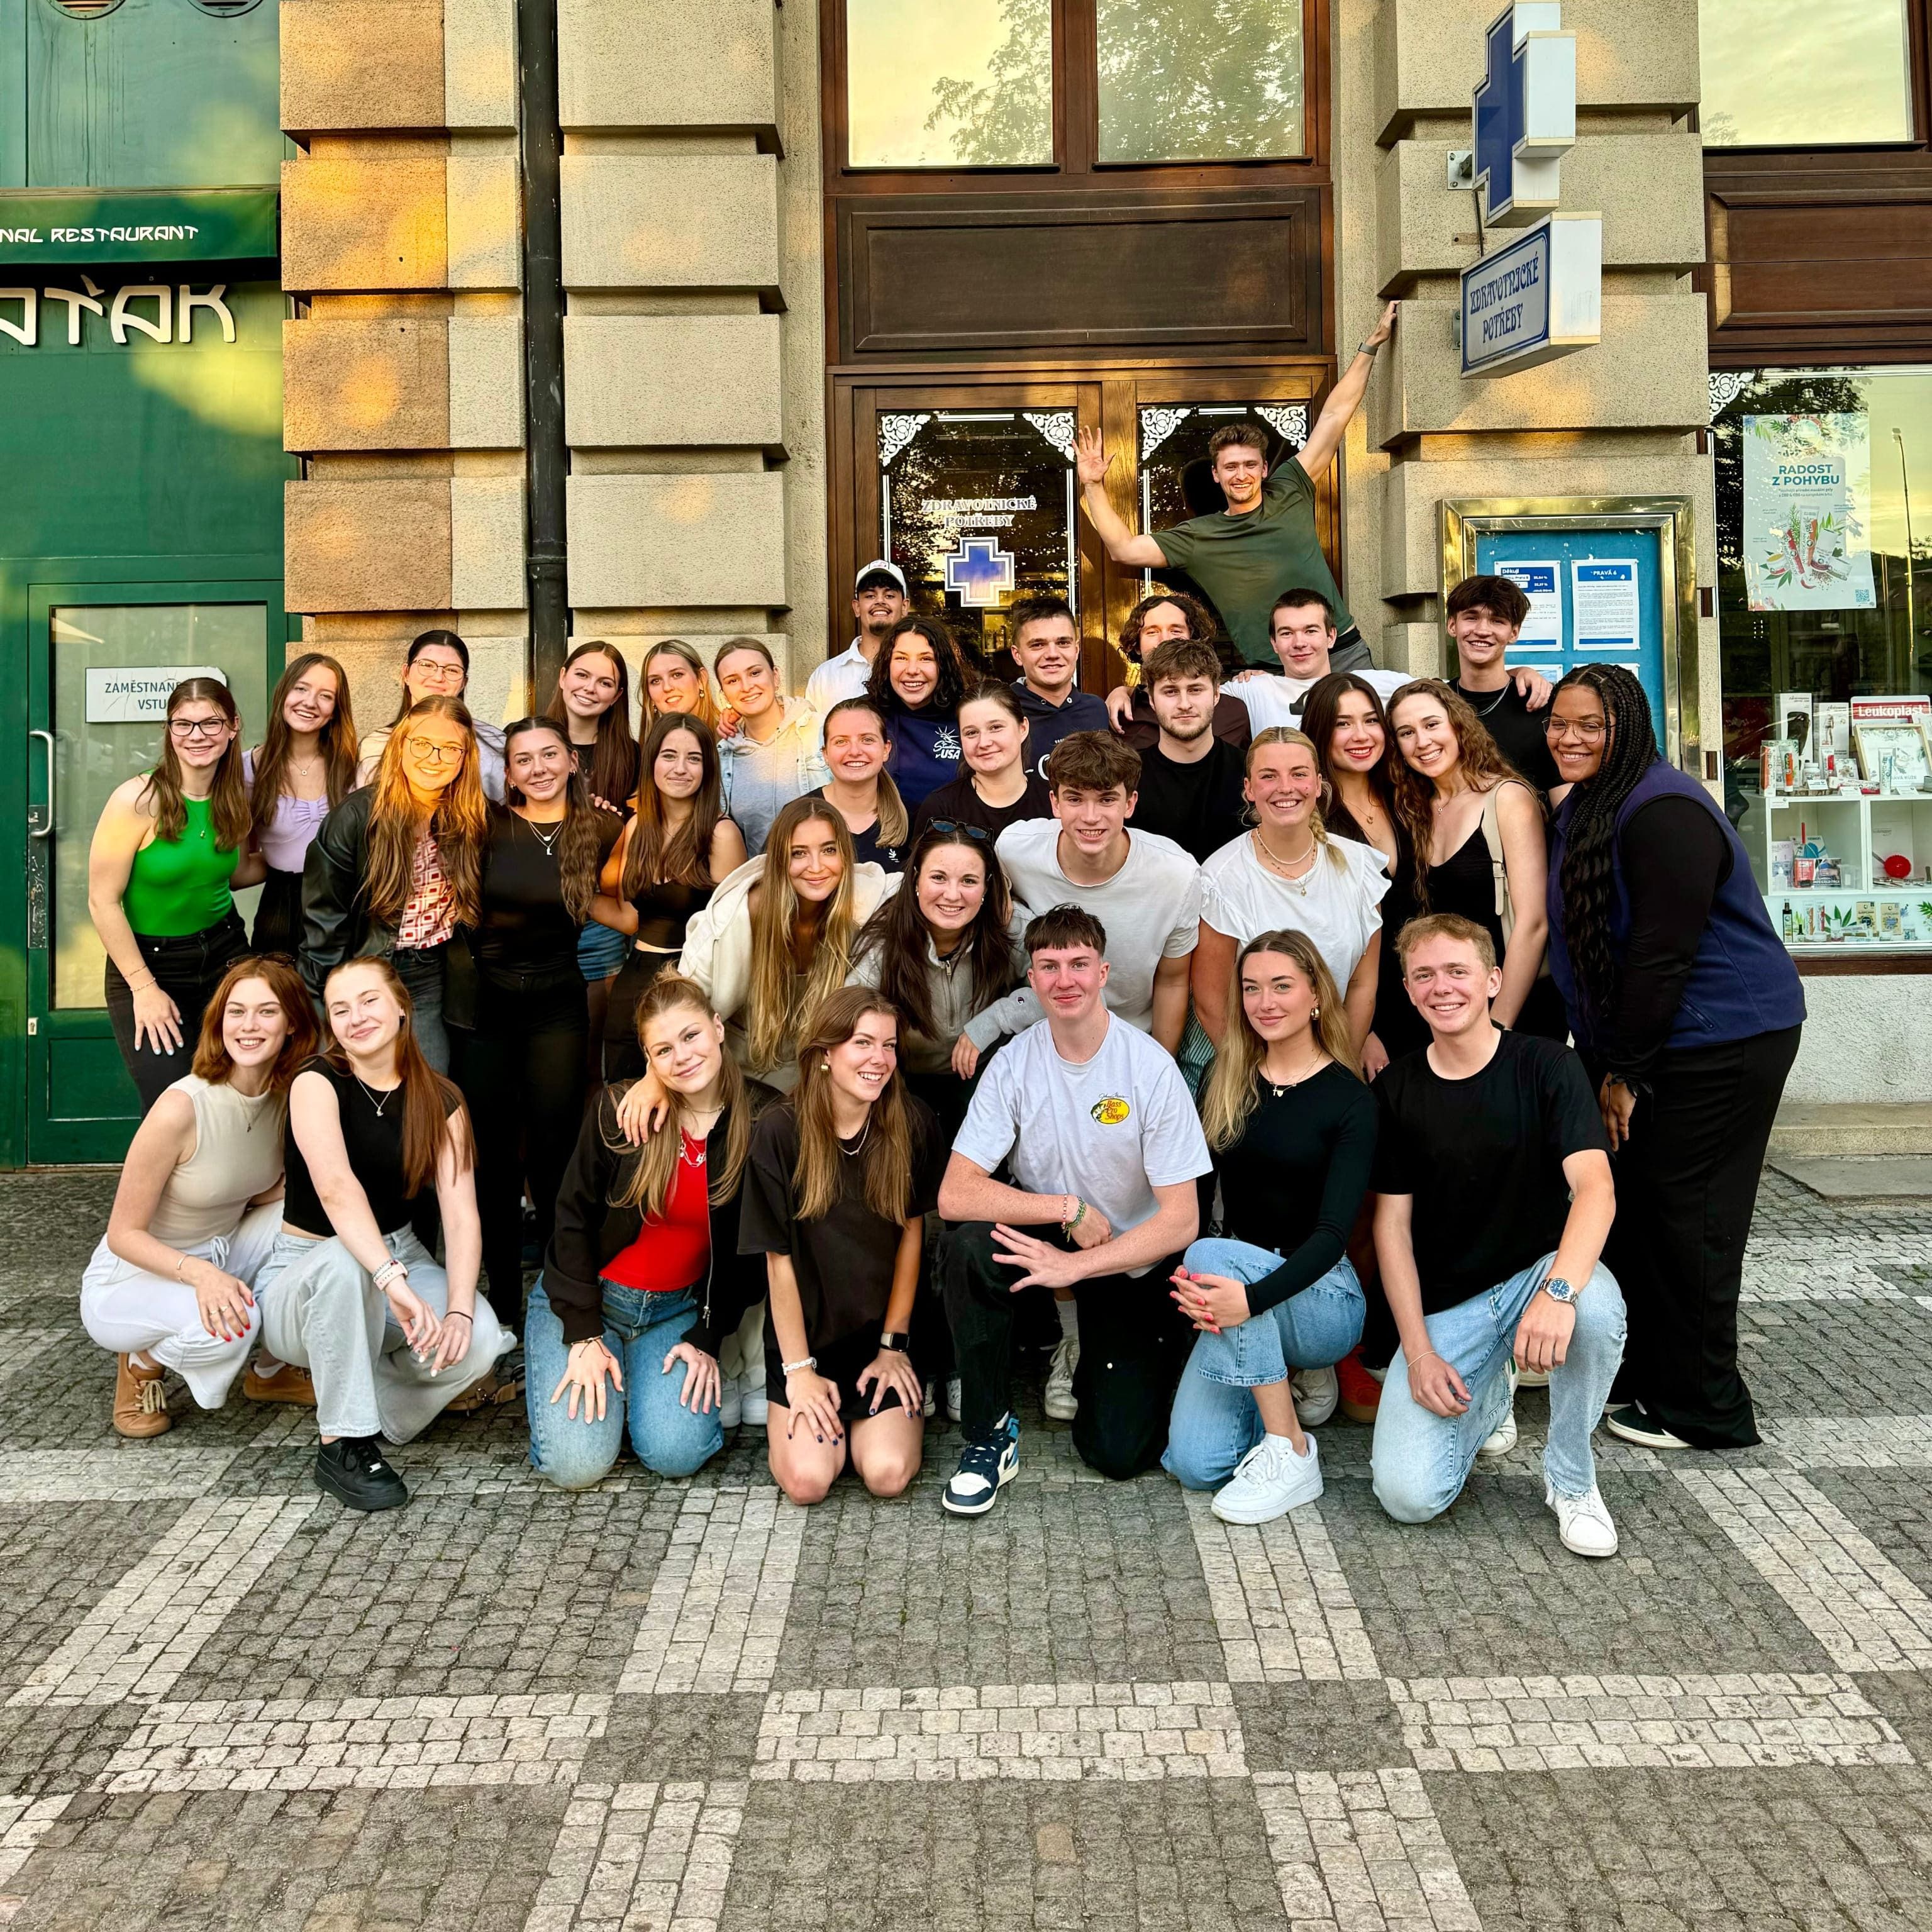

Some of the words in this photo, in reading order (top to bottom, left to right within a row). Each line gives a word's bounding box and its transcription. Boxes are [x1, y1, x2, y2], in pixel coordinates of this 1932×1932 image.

[0, 228, 43, 243] NAL
[51, 226, 199, 243] RESTAURANT
[1470, 252, 1539, 314] ZDRAVOTNICKÉ
[0, 274, 236, 345] AŤAK
[1483, 303, 1523, 343] POTŘEBY
[1779, 464, 1833, 475] RADOST
[1772, 477, 1780, 486] Z
[1784, 475, 1840, 486] POHYBU
[921, 495, 1038, 512] ZDRAVOTNICKÉ
[945, 513, 1015, 528] POTŘEBY
[138, 699, 167, 709] VSTU
[1858, 704, 1924, 719] Leukoplast
[941, 749, 961, 760] USA
